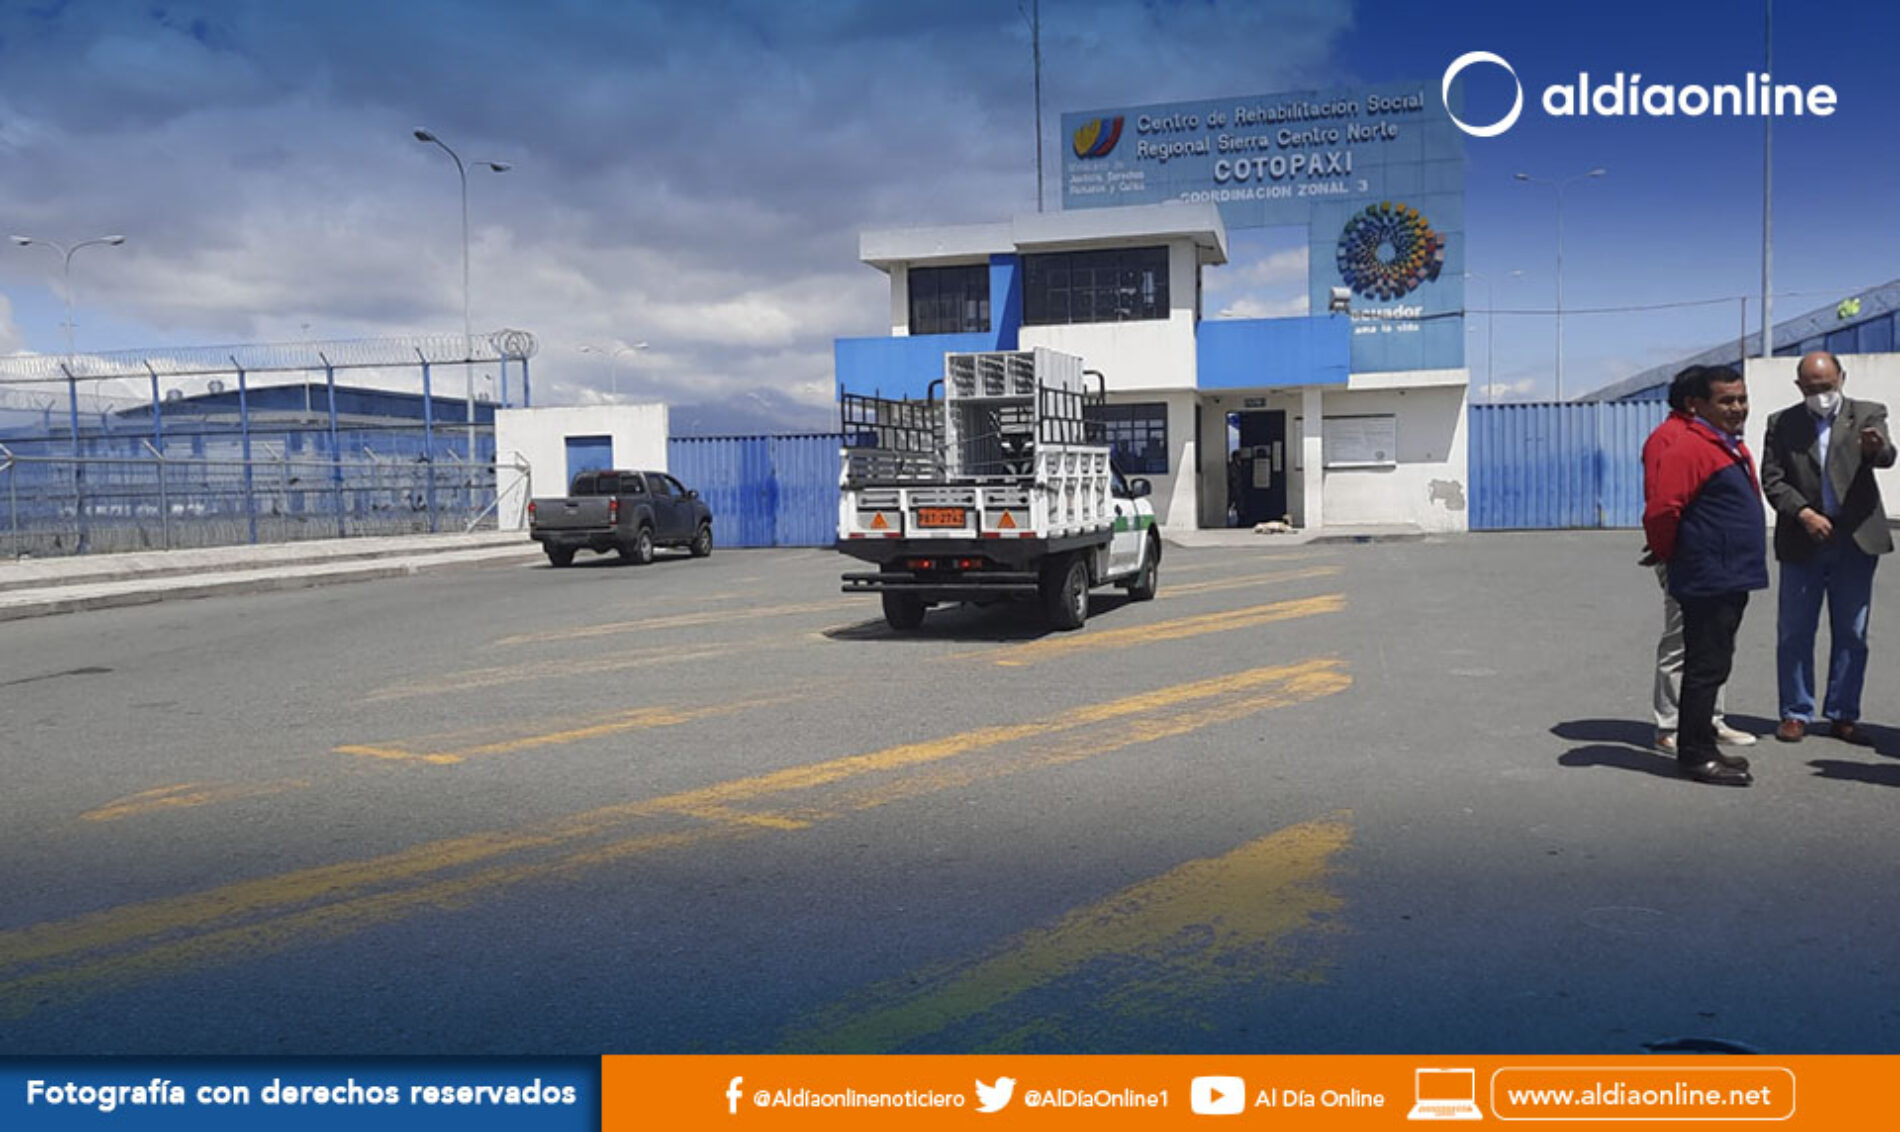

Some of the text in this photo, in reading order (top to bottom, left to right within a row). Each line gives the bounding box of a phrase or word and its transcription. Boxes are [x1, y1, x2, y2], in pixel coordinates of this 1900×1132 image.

[1137, 112, 1199, 132] Centro
[1207, 110, 1226, 126] de
[1367, 90, 1424, 112] Social
[1137, 121, 1399, 159] Regional Sierra Centro Norte
[1214, 152, 1352, 181] COTOPAXI
[1298, 182, 1349, 197] ZONAL
[1358, 180, 1369, 192] 3
[1381, 323, 1392, 333] la
[1396, 322, 1419, 332] vida
